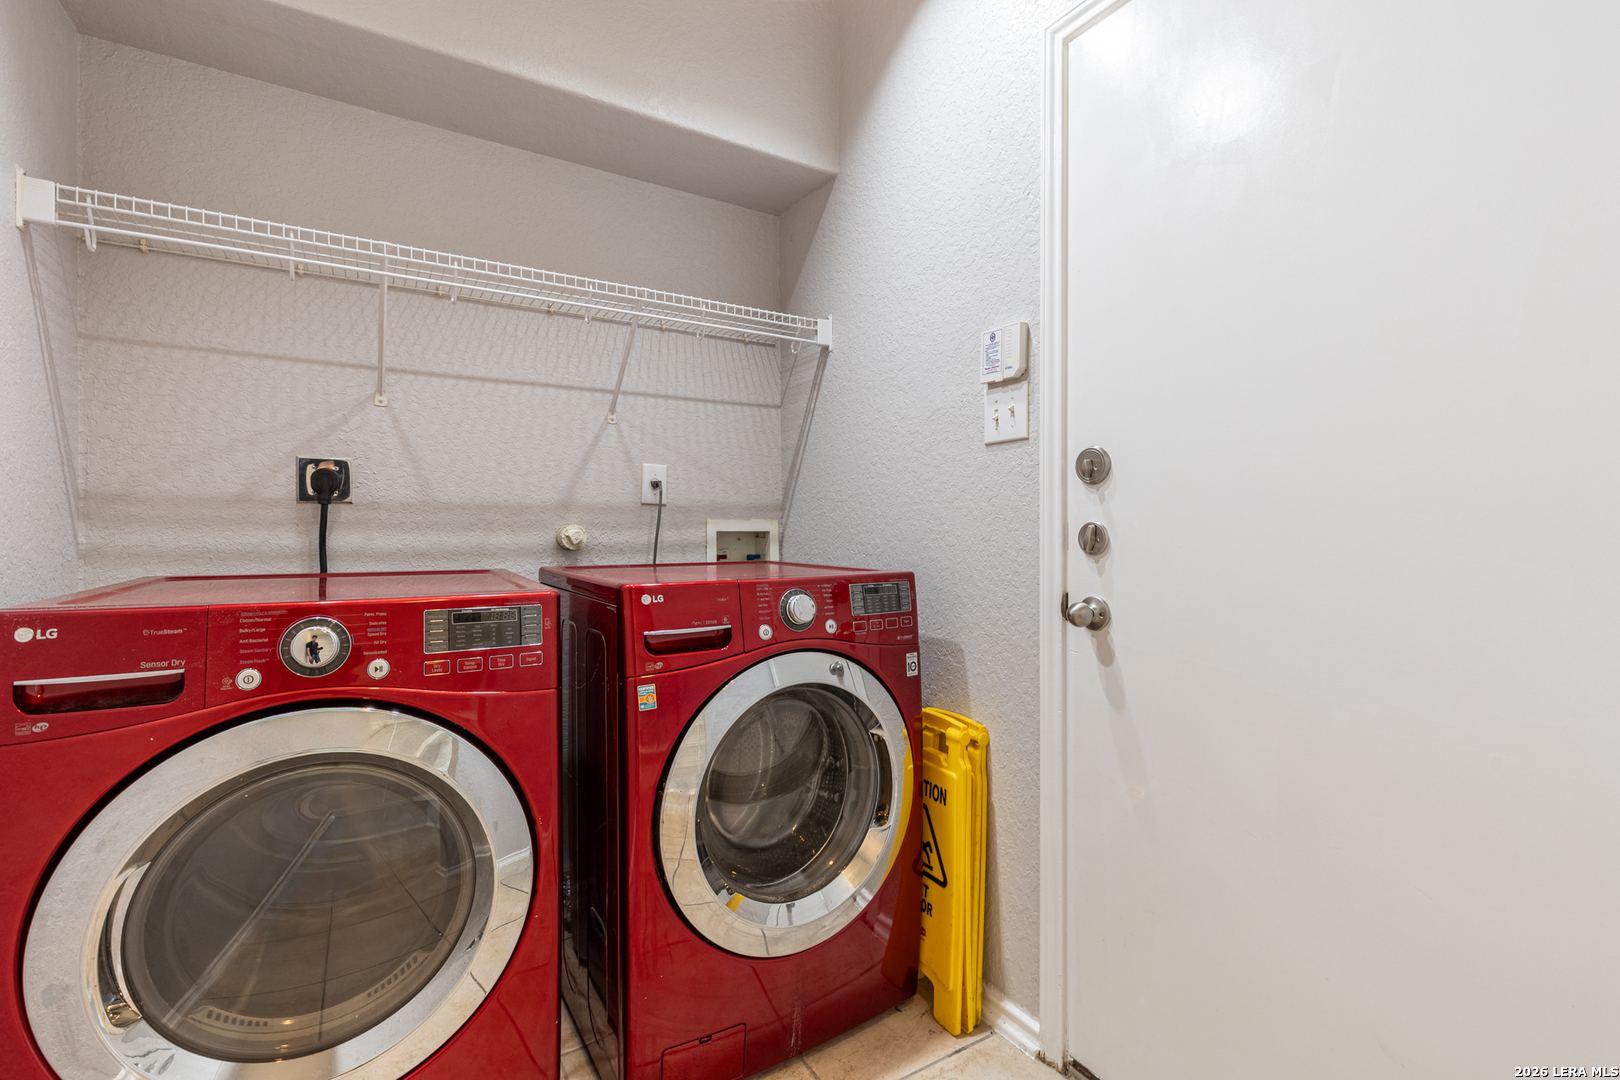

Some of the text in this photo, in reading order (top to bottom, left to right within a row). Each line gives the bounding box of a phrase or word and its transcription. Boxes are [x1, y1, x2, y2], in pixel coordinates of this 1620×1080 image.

[652, 594, 664, 603] LG
[36, 628, 58, 640] LG
[140, 659, 186, 669] Sensor Dry
[923, 779, 947, 807] TION
